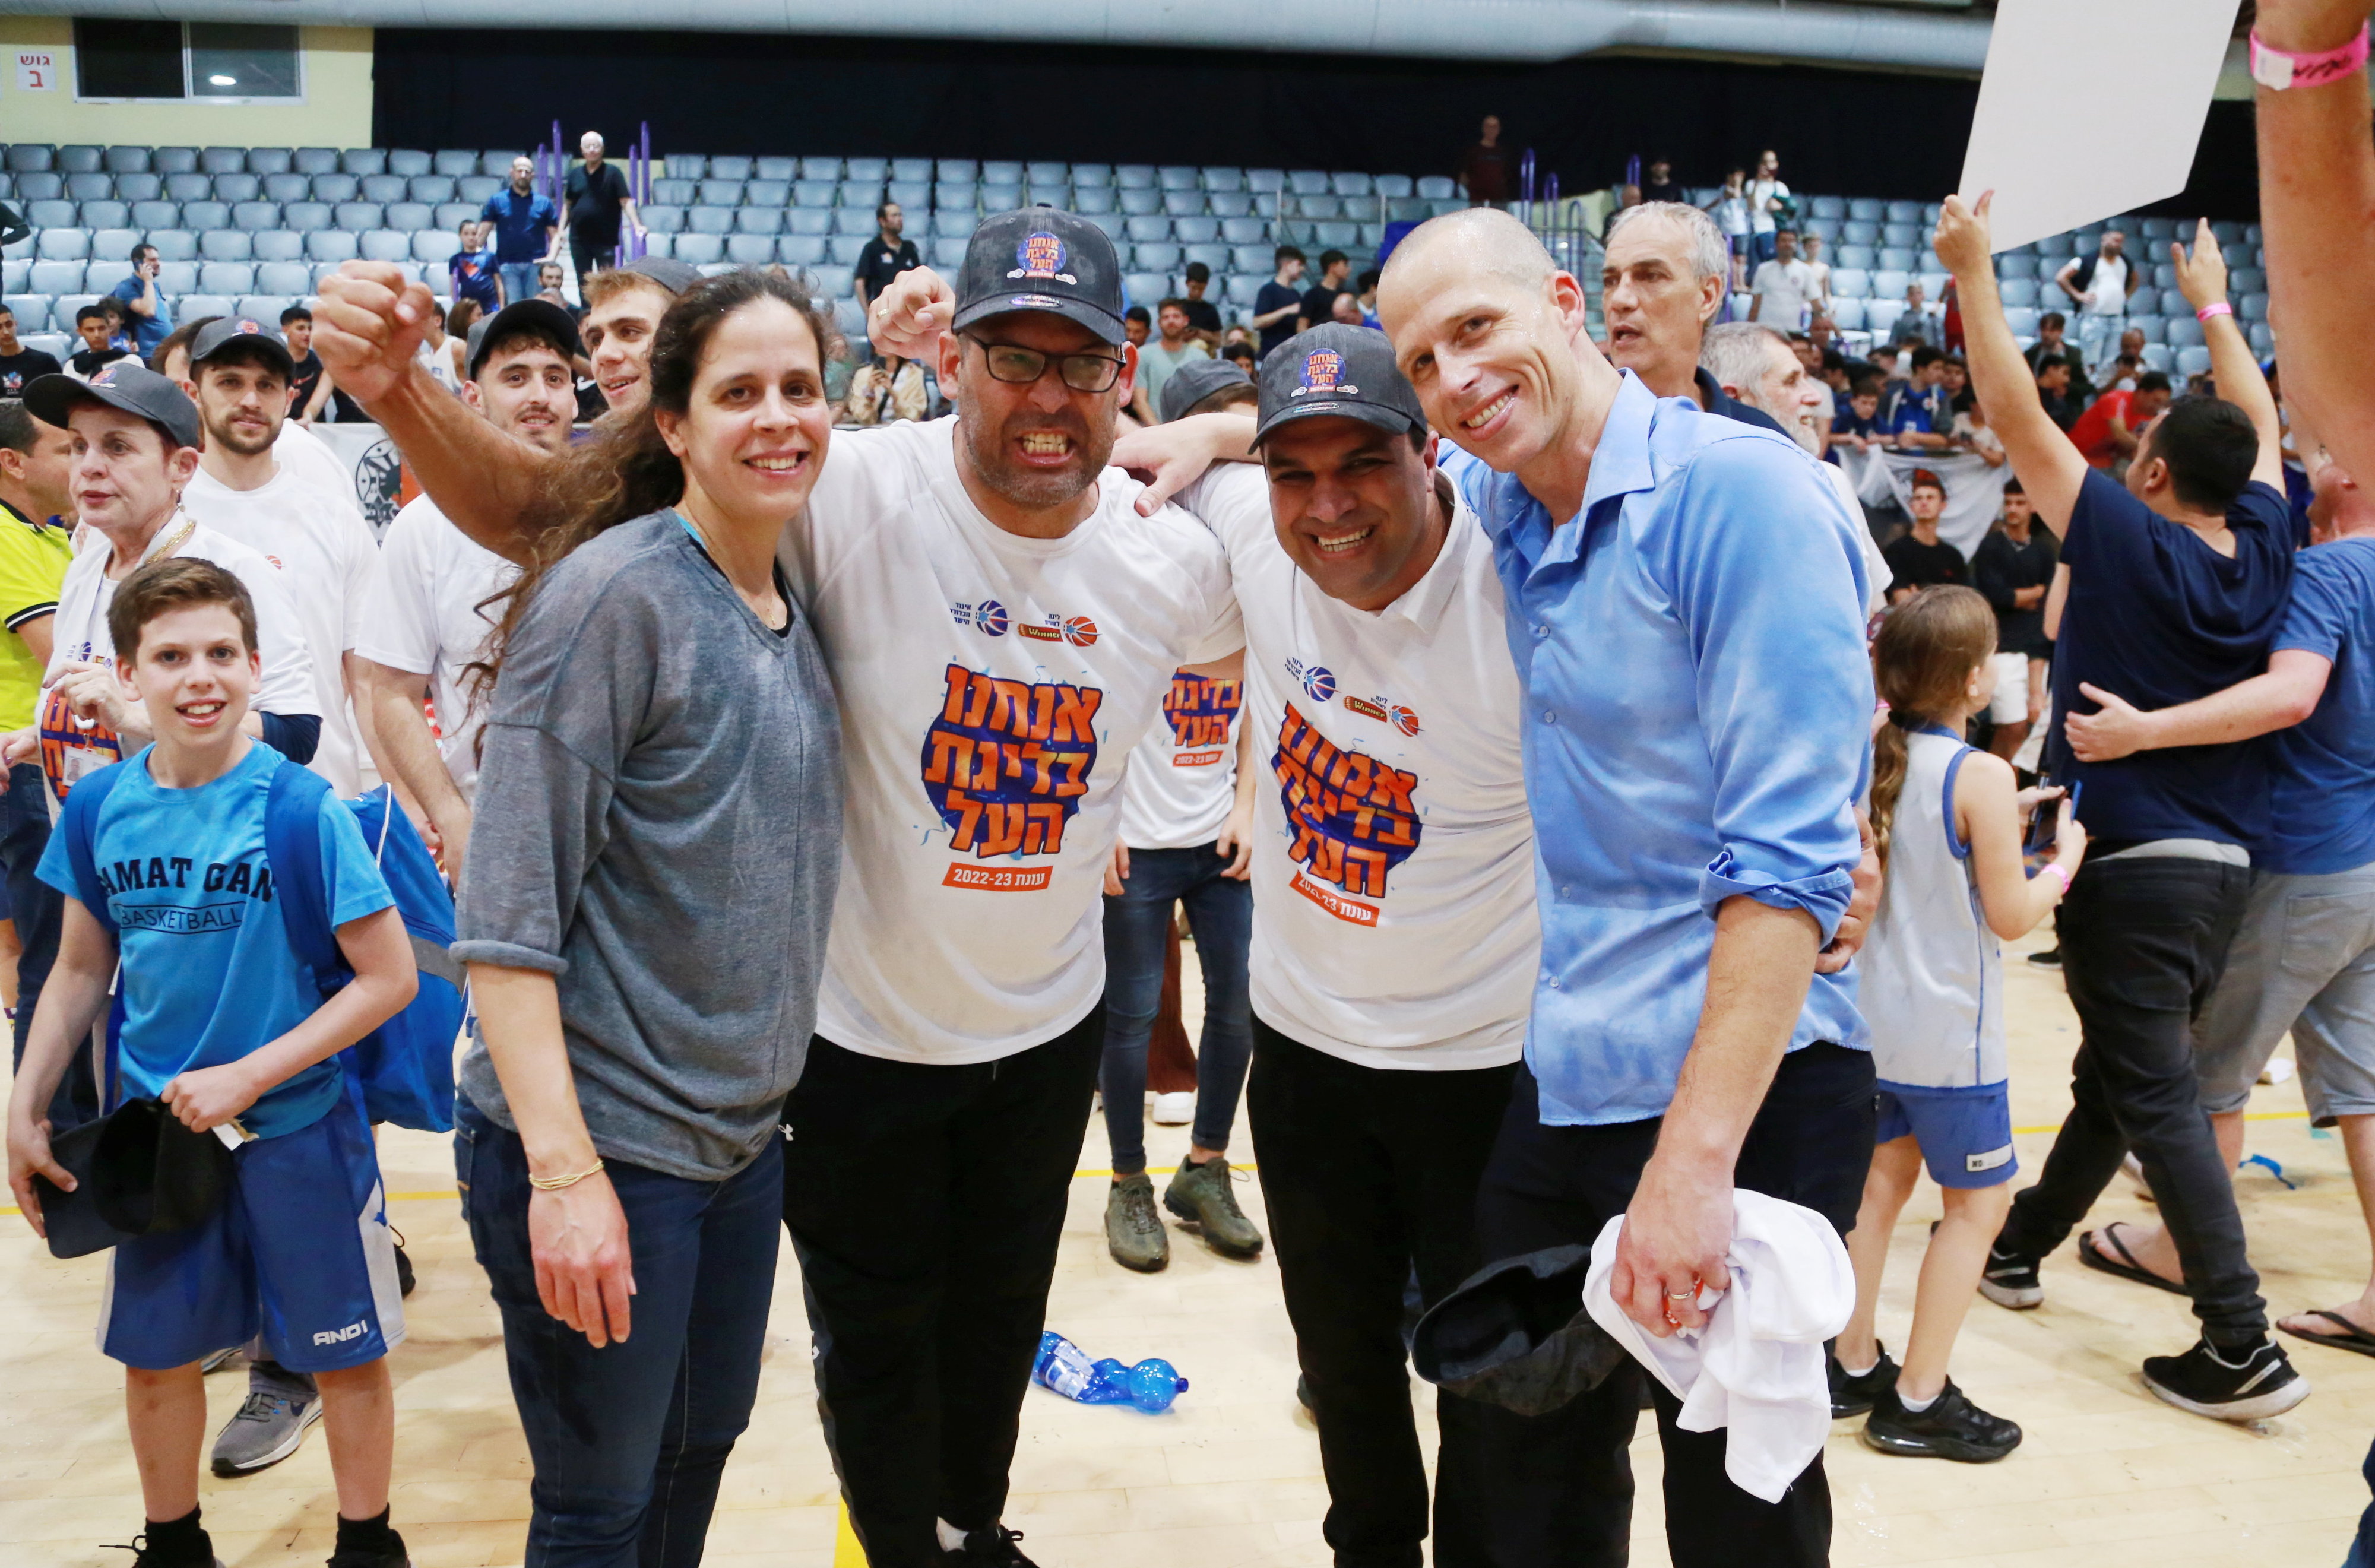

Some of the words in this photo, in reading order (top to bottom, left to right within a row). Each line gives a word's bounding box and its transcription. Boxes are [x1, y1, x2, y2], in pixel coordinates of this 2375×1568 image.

[20, 55, 50, 66] גוש
[28, 70, 43, 88] ב
[1028, 237, 1060, 249] אנחנו
[1030, 258, 1054, 270] העל
[1309, 353, 1339, 366] אנחנו
[1310, 373, 1334, 385] העל
[954, 617, 970, 625] הישר
[1028, 628, 1060, 638] Winner
[944, 663, 1103, 743] אנחנו
[1354, 700, 1386, 718] Winner
[1172, 711, 1228, 747] העל
[924, 729, 1089, 797] בליגת
[1279, 701, 1418, 814] אנחנו
[945, 788, 1064, 858] העל
[1288, 811, 1387, 898] העל
[99, 856, 193, 897] AMAT
[203, 862, 273, 902] GAN
[953, 867, 1012, 887] 2022-23
[1015, 872, 1046, 886] עונת
[121, 906, 243, 930] BASKETBALL
[1340, 901, 1372, 921] עונת
